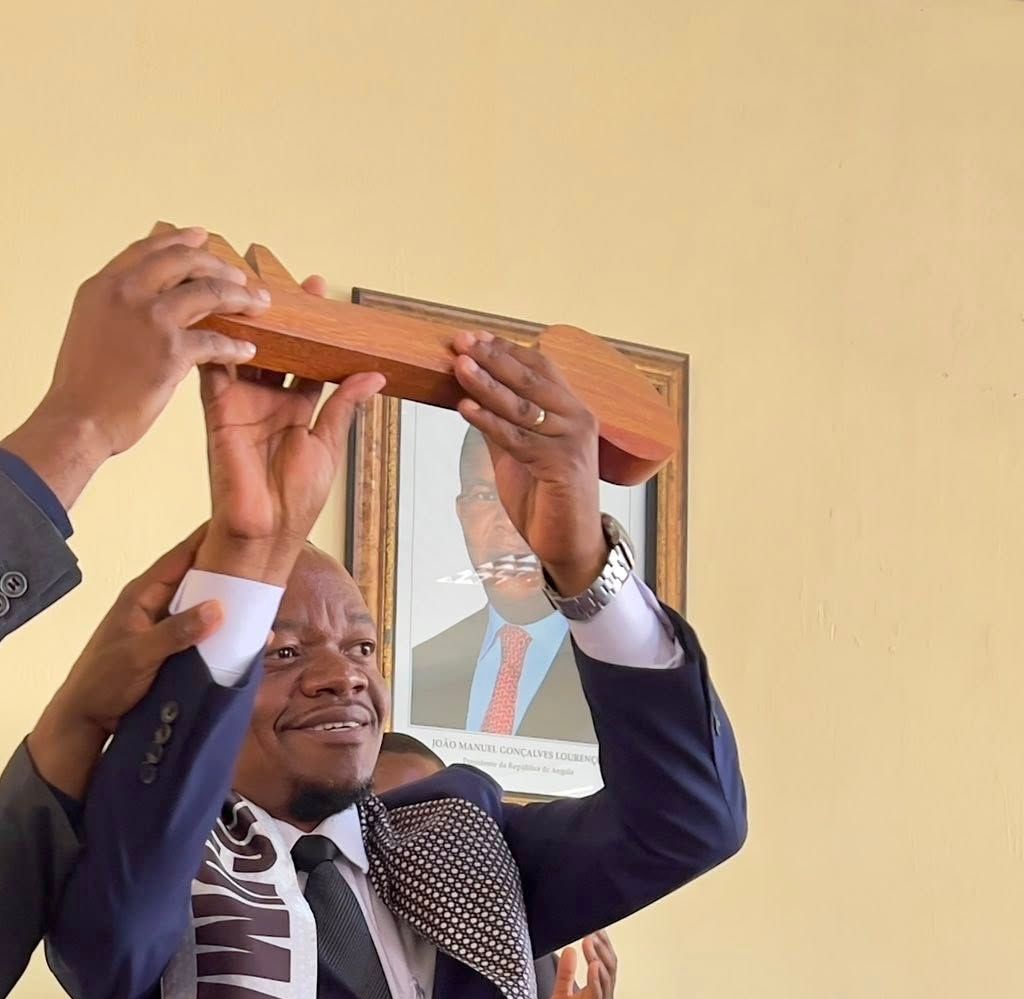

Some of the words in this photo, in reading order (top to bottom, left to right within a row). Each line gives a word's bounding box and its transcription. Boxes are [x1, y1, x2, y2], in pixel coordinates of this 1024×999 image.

[432, 737, 457, 750] JOÃO
[458, 741, 498, 754] MANUEL
[499, 745, 554, 761] GONÇALVES
[555, 751, 598, 766] LOURENÇ
